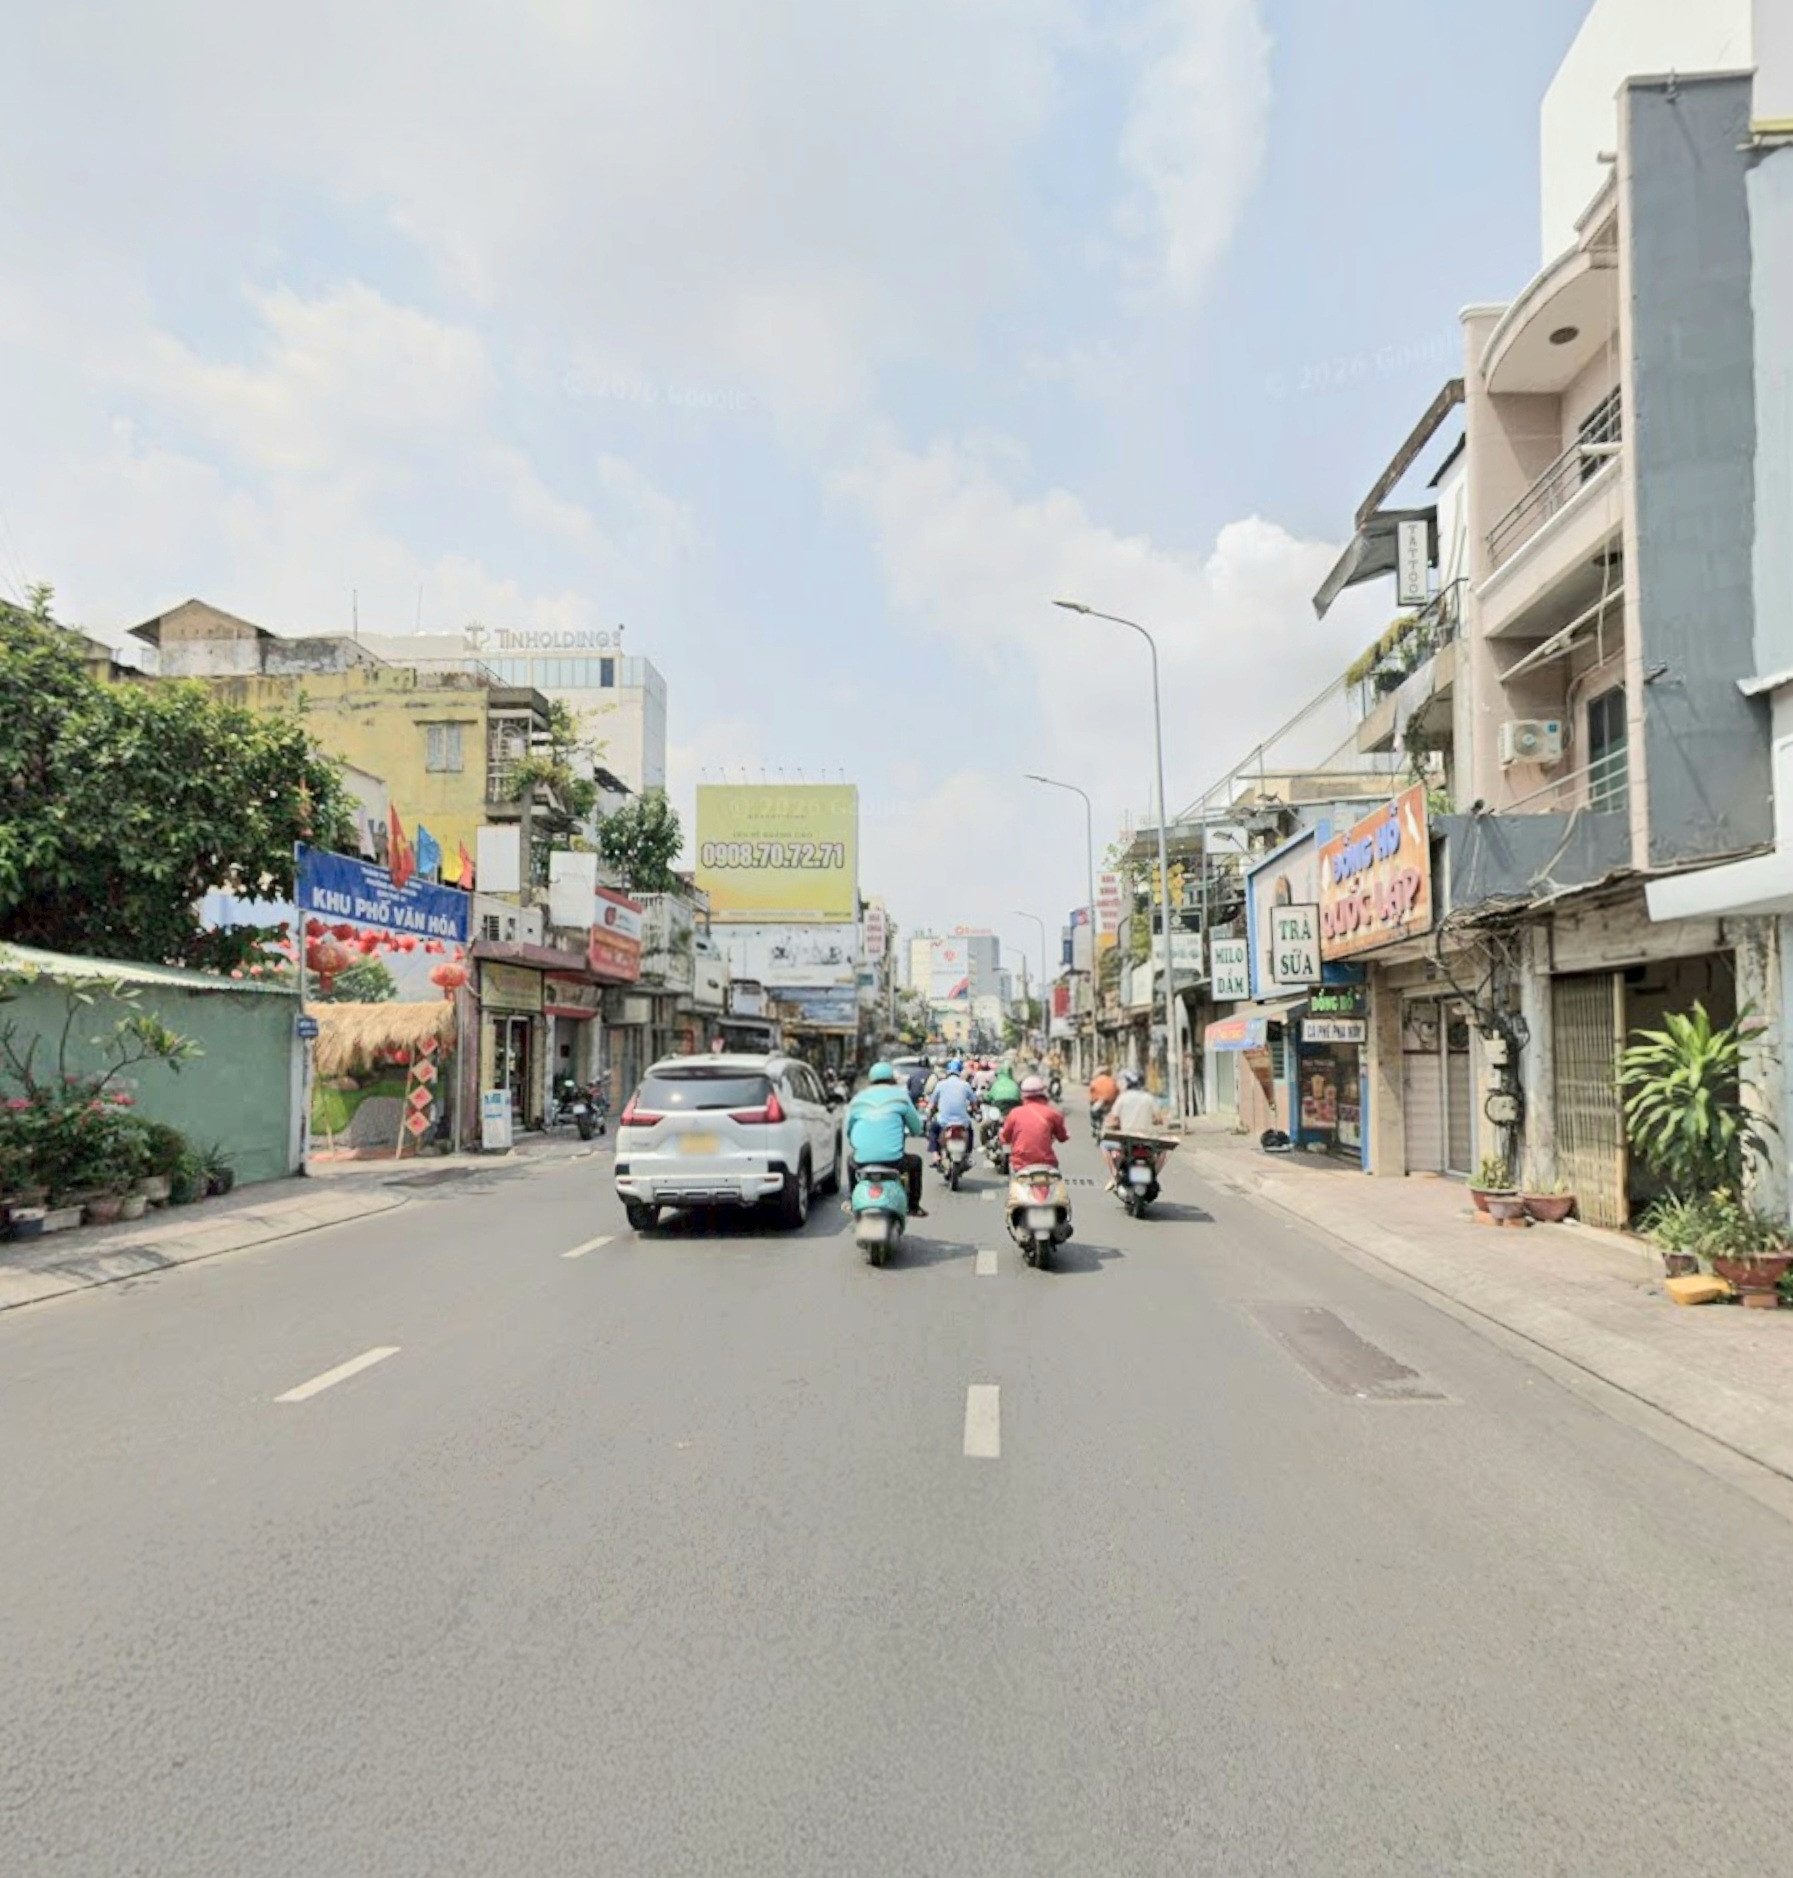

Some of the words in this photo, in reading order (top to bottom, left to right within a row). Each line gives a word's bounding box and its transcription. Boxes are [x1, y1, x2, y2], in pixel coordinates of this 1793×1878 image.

[1408, 523, 1419, 593] TATTOO
[701, 841, 845, 869] 0908.70.72.71
[313, 886, 351, 914] KHU
[355, 898, 392, 923] PHỐ
[394, 906, 425, 930] VĂN
[428, 914, 458, 938] HÓA
[1279, 911, 1312, 940] TRÀ
[1280, 948, 1314, 975] SỮA
